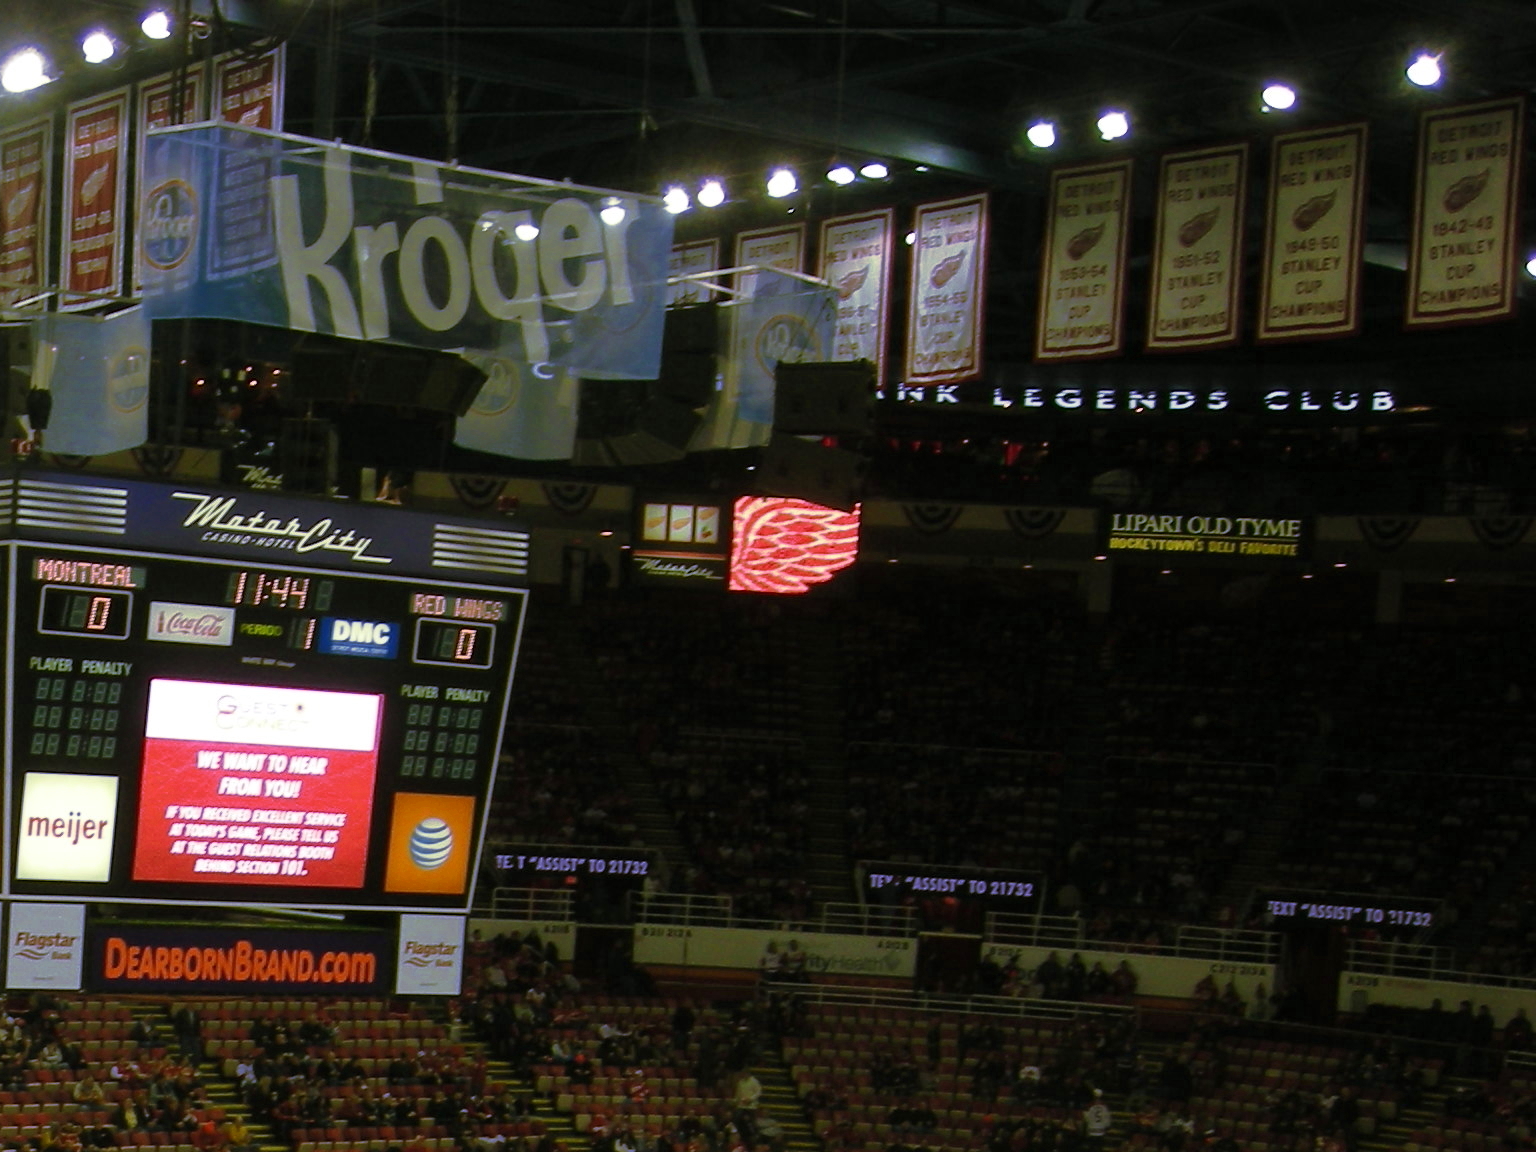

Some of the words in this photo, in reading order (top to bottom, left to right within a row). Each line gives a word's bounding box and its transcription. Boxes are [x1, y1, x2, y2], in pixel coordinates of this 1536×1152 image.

[270, 148, 640, 364] Kroger
[1429, 238, 1494, 260] STANLEY
[992, 386, 1227, 411] LEGENDS
[1262, 390, 1391, 412] CLUB
[1110, 513, 1184, 534] LIPARI
[1186, 515, 1233, 535] OLD
[1235, 518, 1302, 538] TYME
[36, 557, 137, 588] MONTREAL
[412, 592, 446, 617] RED
[452, 597, 505, 621] WINGS
[332, 619, 391, 645] DMC
[29, 655, 74, 674] PLAYER
[81, 657, 134, 678] PENALTY
[401, 684, 440, 701] PLAYER
[444, 686, 492, 704] PENALTY
[196, 750, 223, 769] WE
[223, 751, 267, 773] WANT
[266, 753, 288, 773] TO
[288, 755, 329, 776] HEAR
[217, 776, 263, 798] FROM
[263, 778, 303, 799] YOU!
[164, 804, 180, 819] IF
[179, 805, 203, 821] YOU
[27, 811, 108, 846] meijer
[495, 854, 527, 870] TET
[587, 858, 606, 874] TO
[607, 860, 649, 876] 21732
[967, 880, 987, 896] TO
[989, 881, 1034, 898] 21732
[1364, 907, 1383, 924] TO
[15, 931, 78, 950] Flagstar
[405, 940, 458, 959] Flagstar
